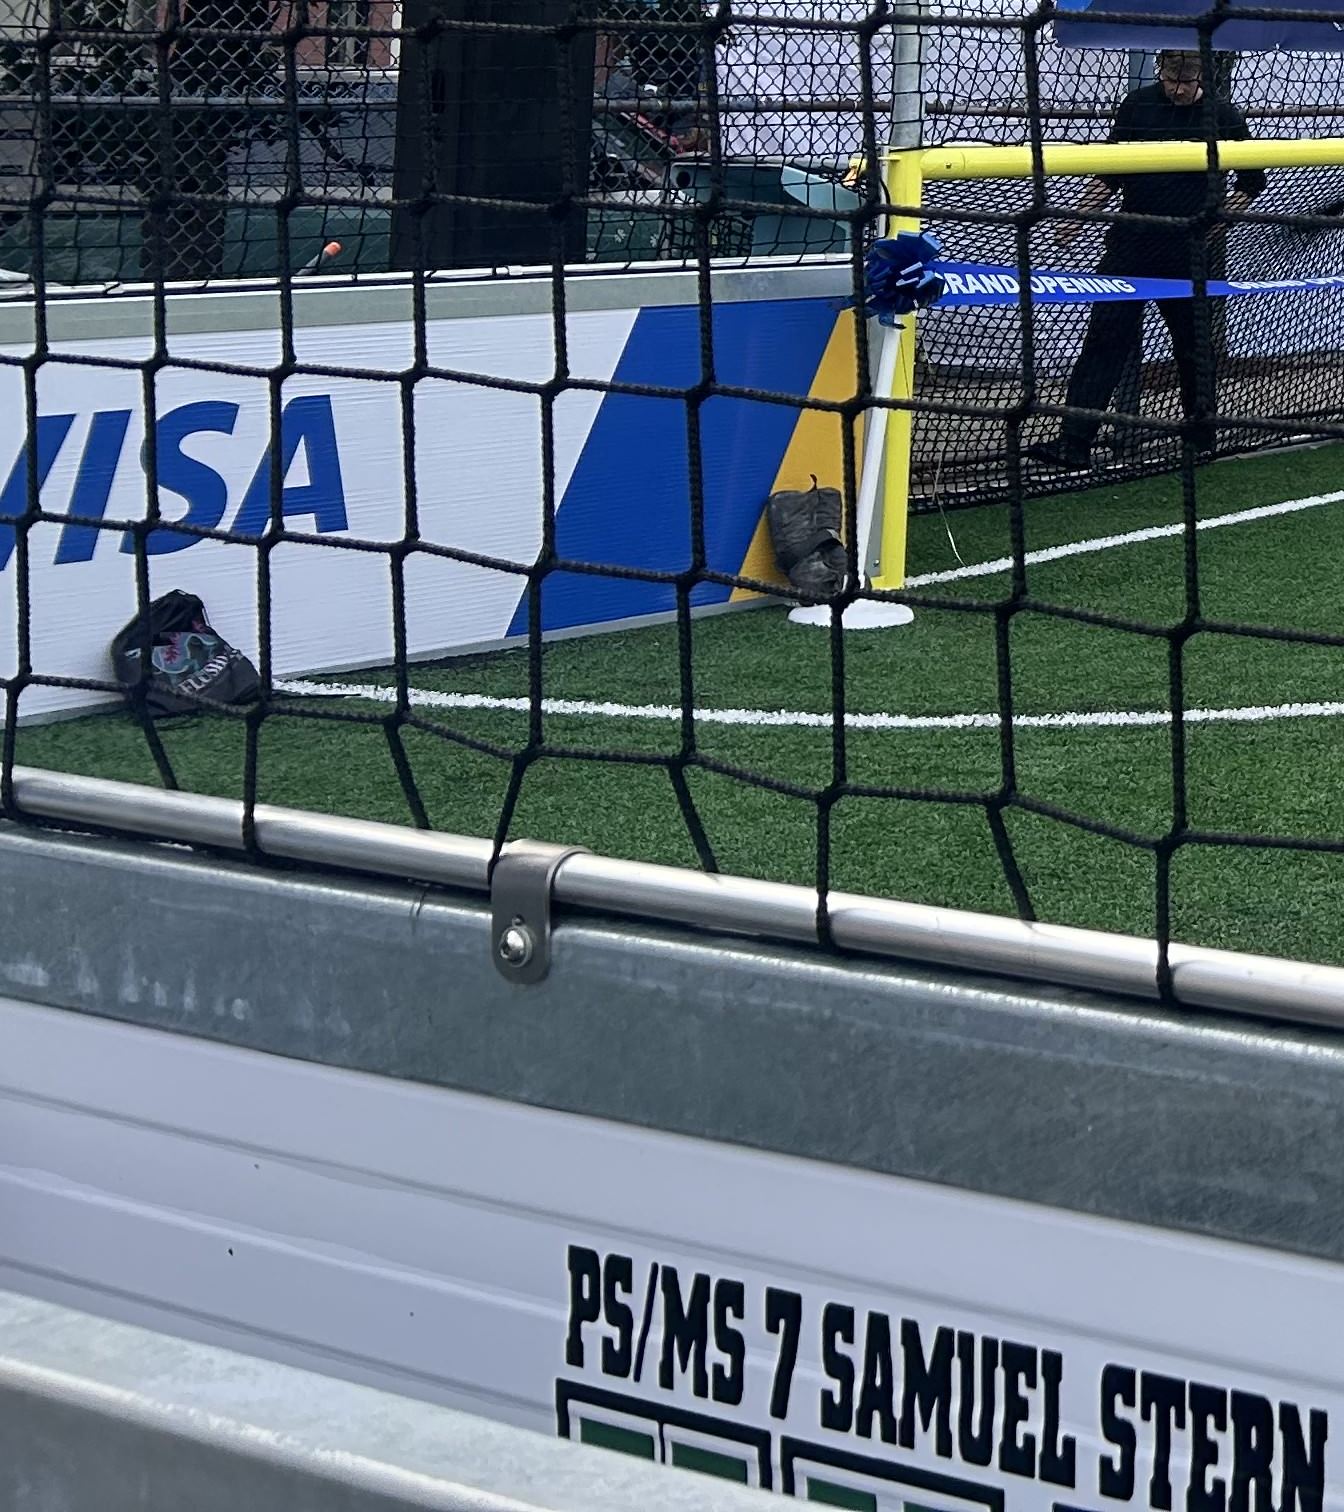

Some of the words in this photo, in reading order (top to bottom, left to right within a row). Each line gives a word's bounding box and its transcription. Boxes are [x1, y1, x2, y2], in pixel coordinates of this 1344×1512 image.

[1029, 276, 1136, 294] OPENING
[565, 1244, 745, 1406] PS/MS
[765, 1286, 802, 1419] 7
[820, 1302, 1076, 1489] SAMUEL
[1099, 1363, 1328, 1512] STERN
